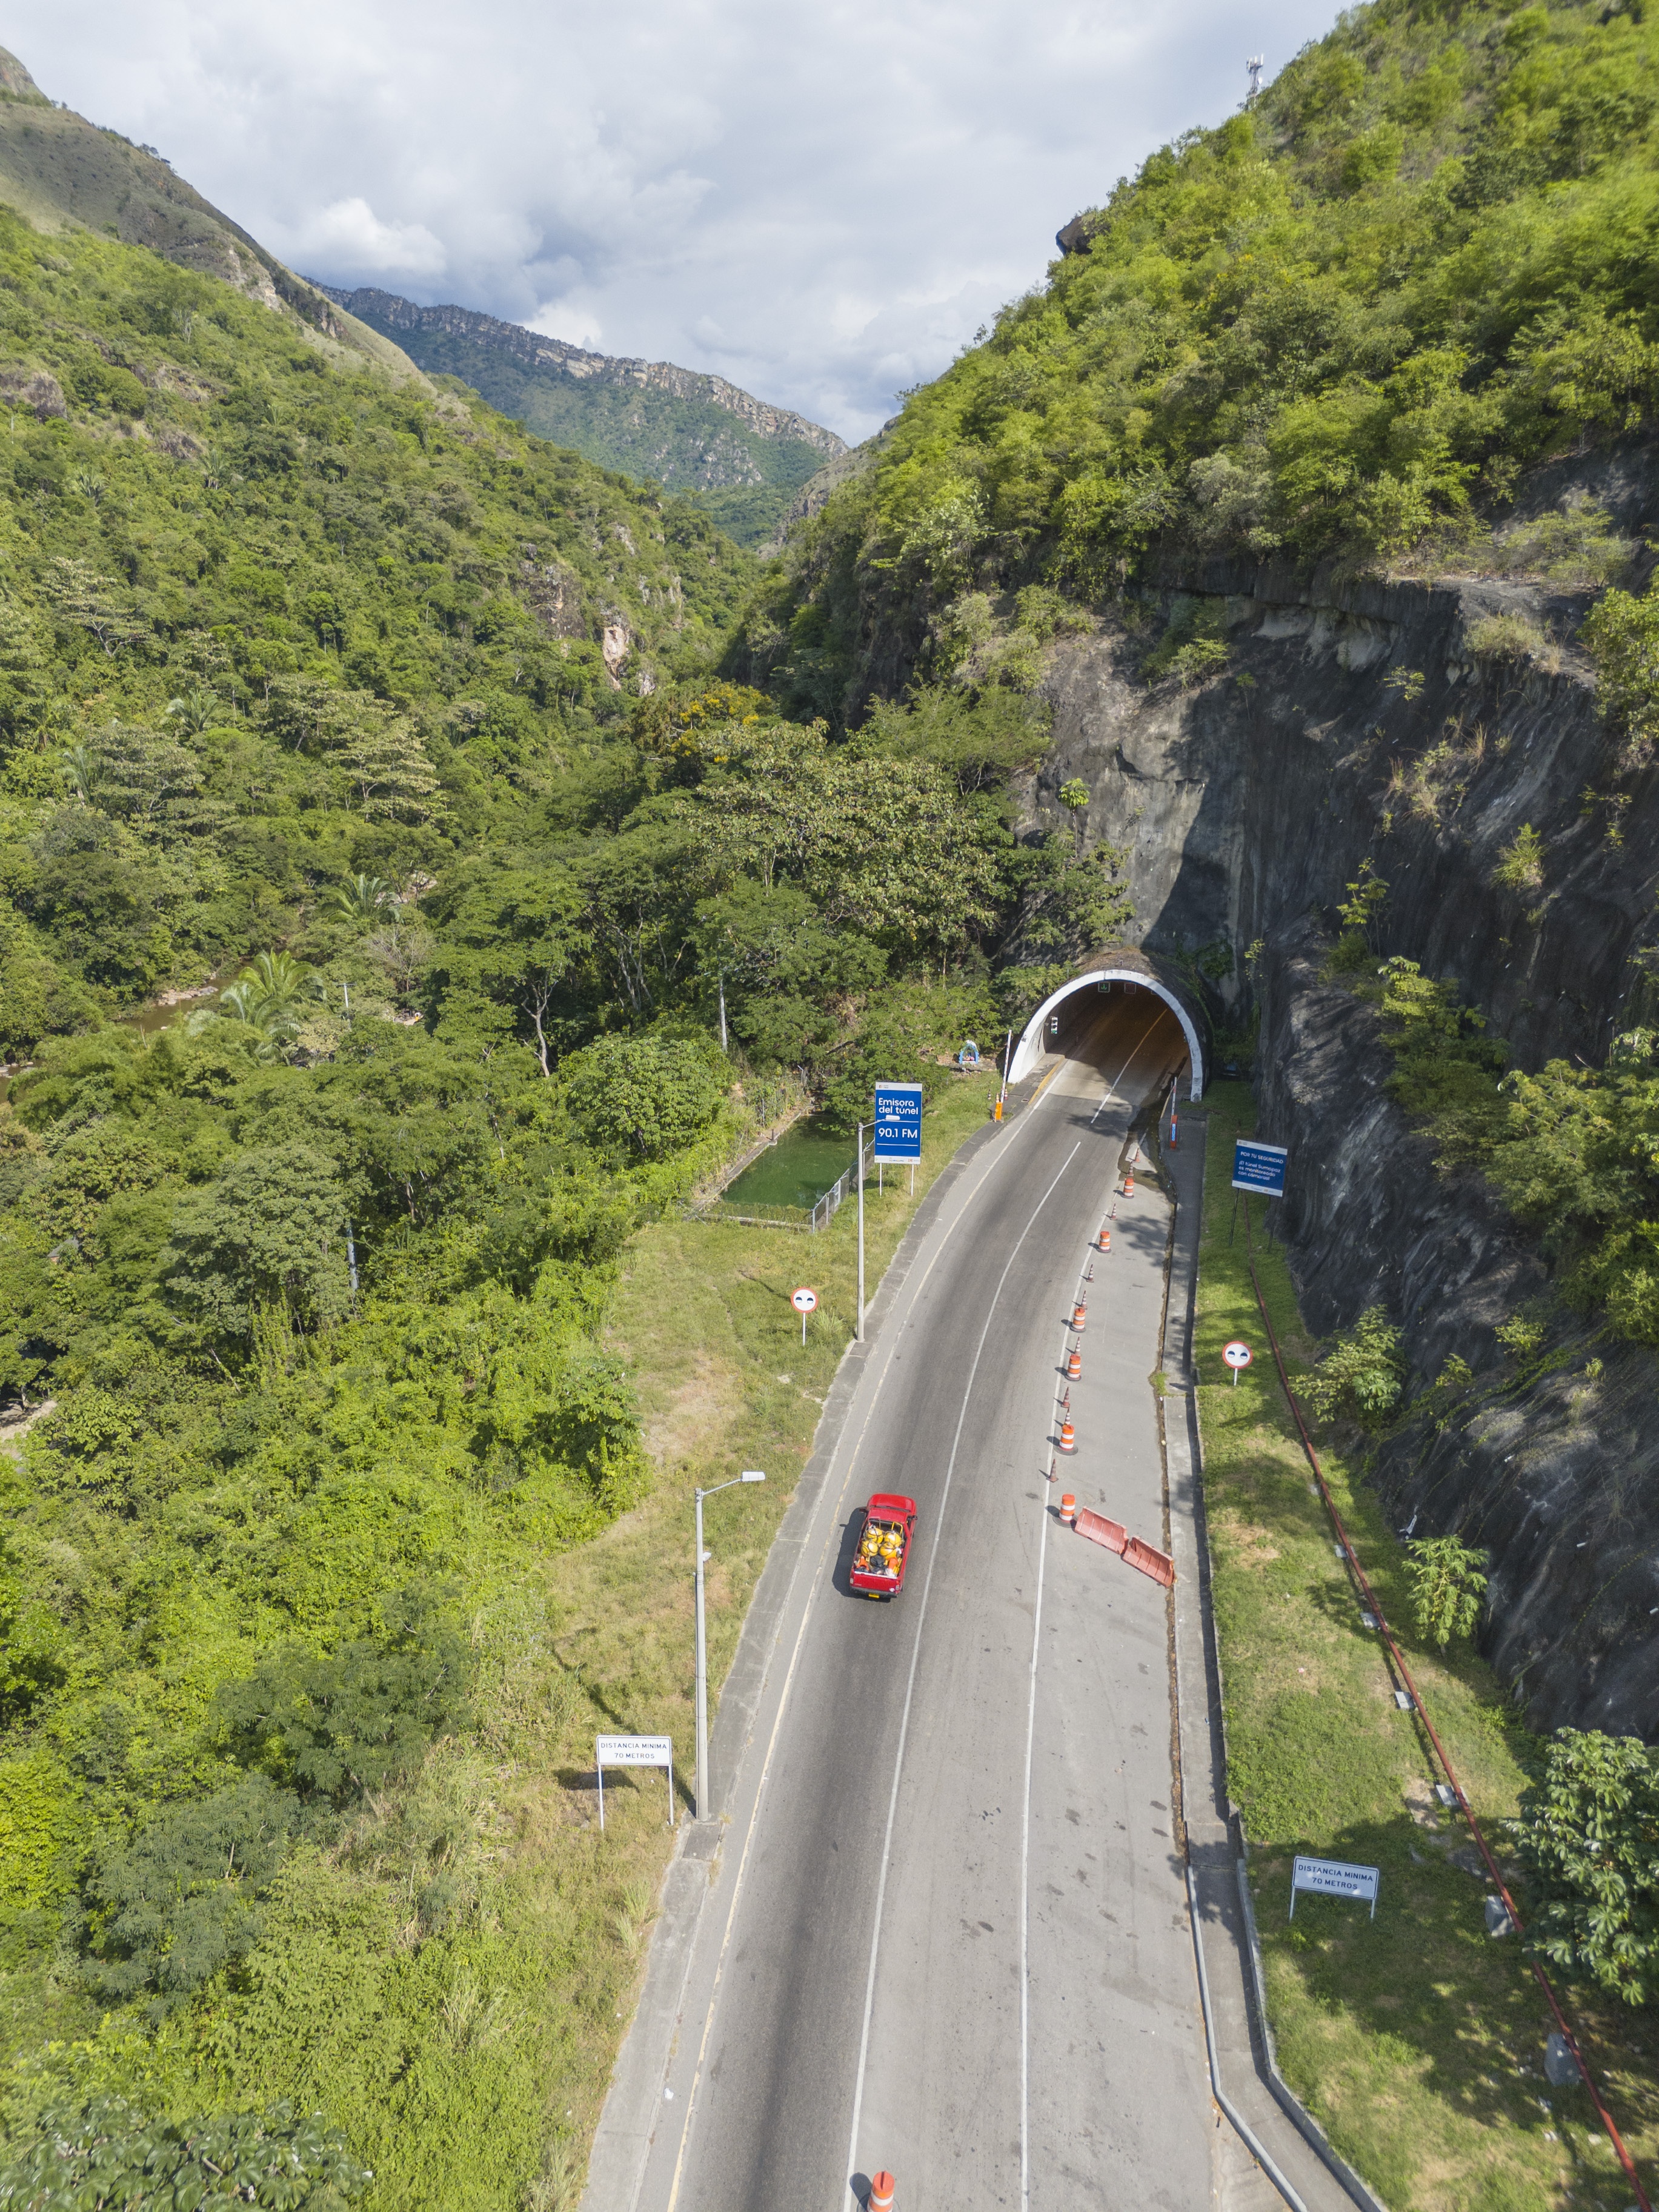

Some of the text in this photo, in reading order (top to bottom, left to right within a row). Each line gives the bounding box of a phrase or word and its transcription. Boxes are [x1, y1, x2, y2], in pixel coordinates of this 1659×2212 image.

[879, 1098, 914, 1107] Emisora
[896, 1106, 919, 1115] túnel
[879, 1128, 917, 1138] 90.1 FM
[1257, 1155, 1283, 1164] SEGURIDAD
[1245, 1167, 1275, 1177] monitoreado
[1258, 1164, 1281, 1173] Sumapaz
[1298, 1864, 1373, 1882] DISTANCIA MINIMA
[1325, 1879, 1358, 1890] METROS
